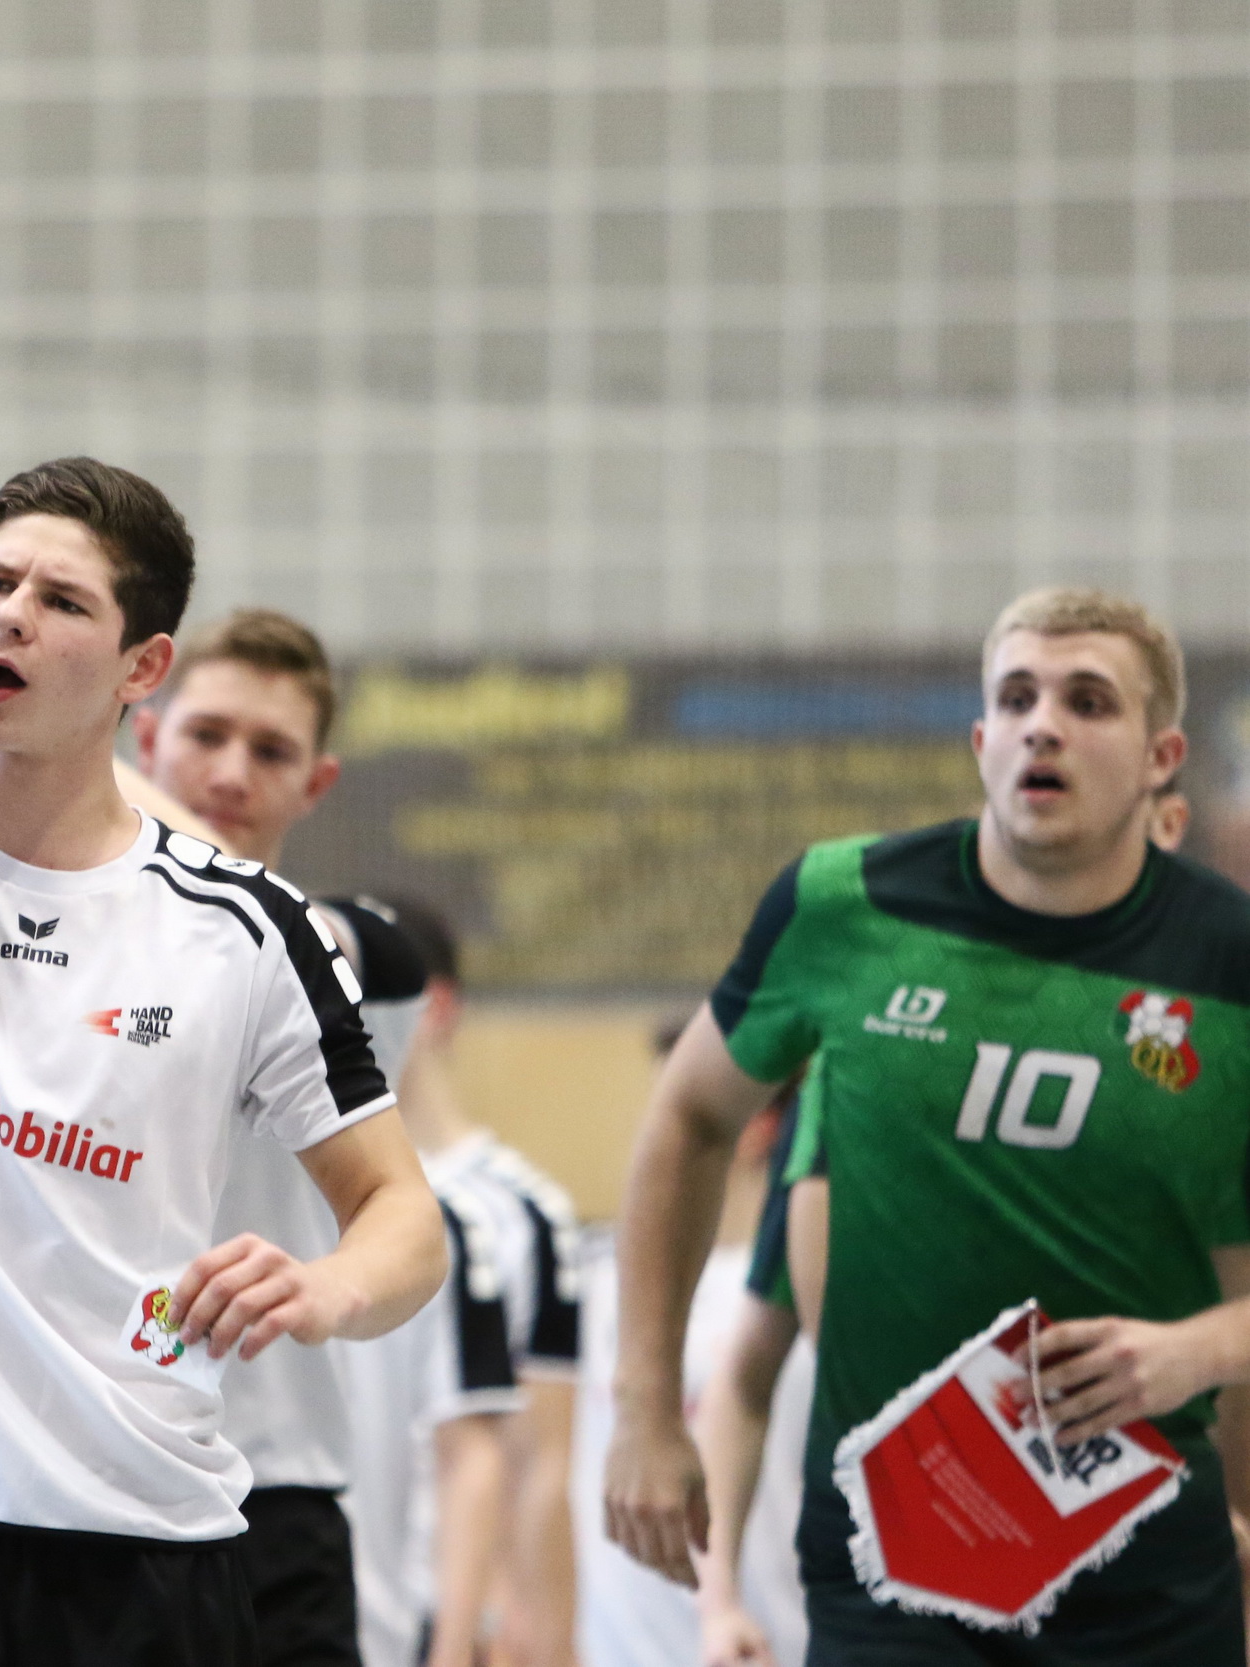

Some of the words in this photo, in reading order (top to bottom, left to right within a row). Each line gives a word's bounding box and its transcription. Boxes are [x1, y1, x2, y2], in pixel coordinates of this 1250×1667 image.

[0, 943, 69, 967] erima
[130, 1006, 173, 1021] HAND
[136, 1020, 171, 1038] BALL
[955, 1042, 1102, 1149] 10
